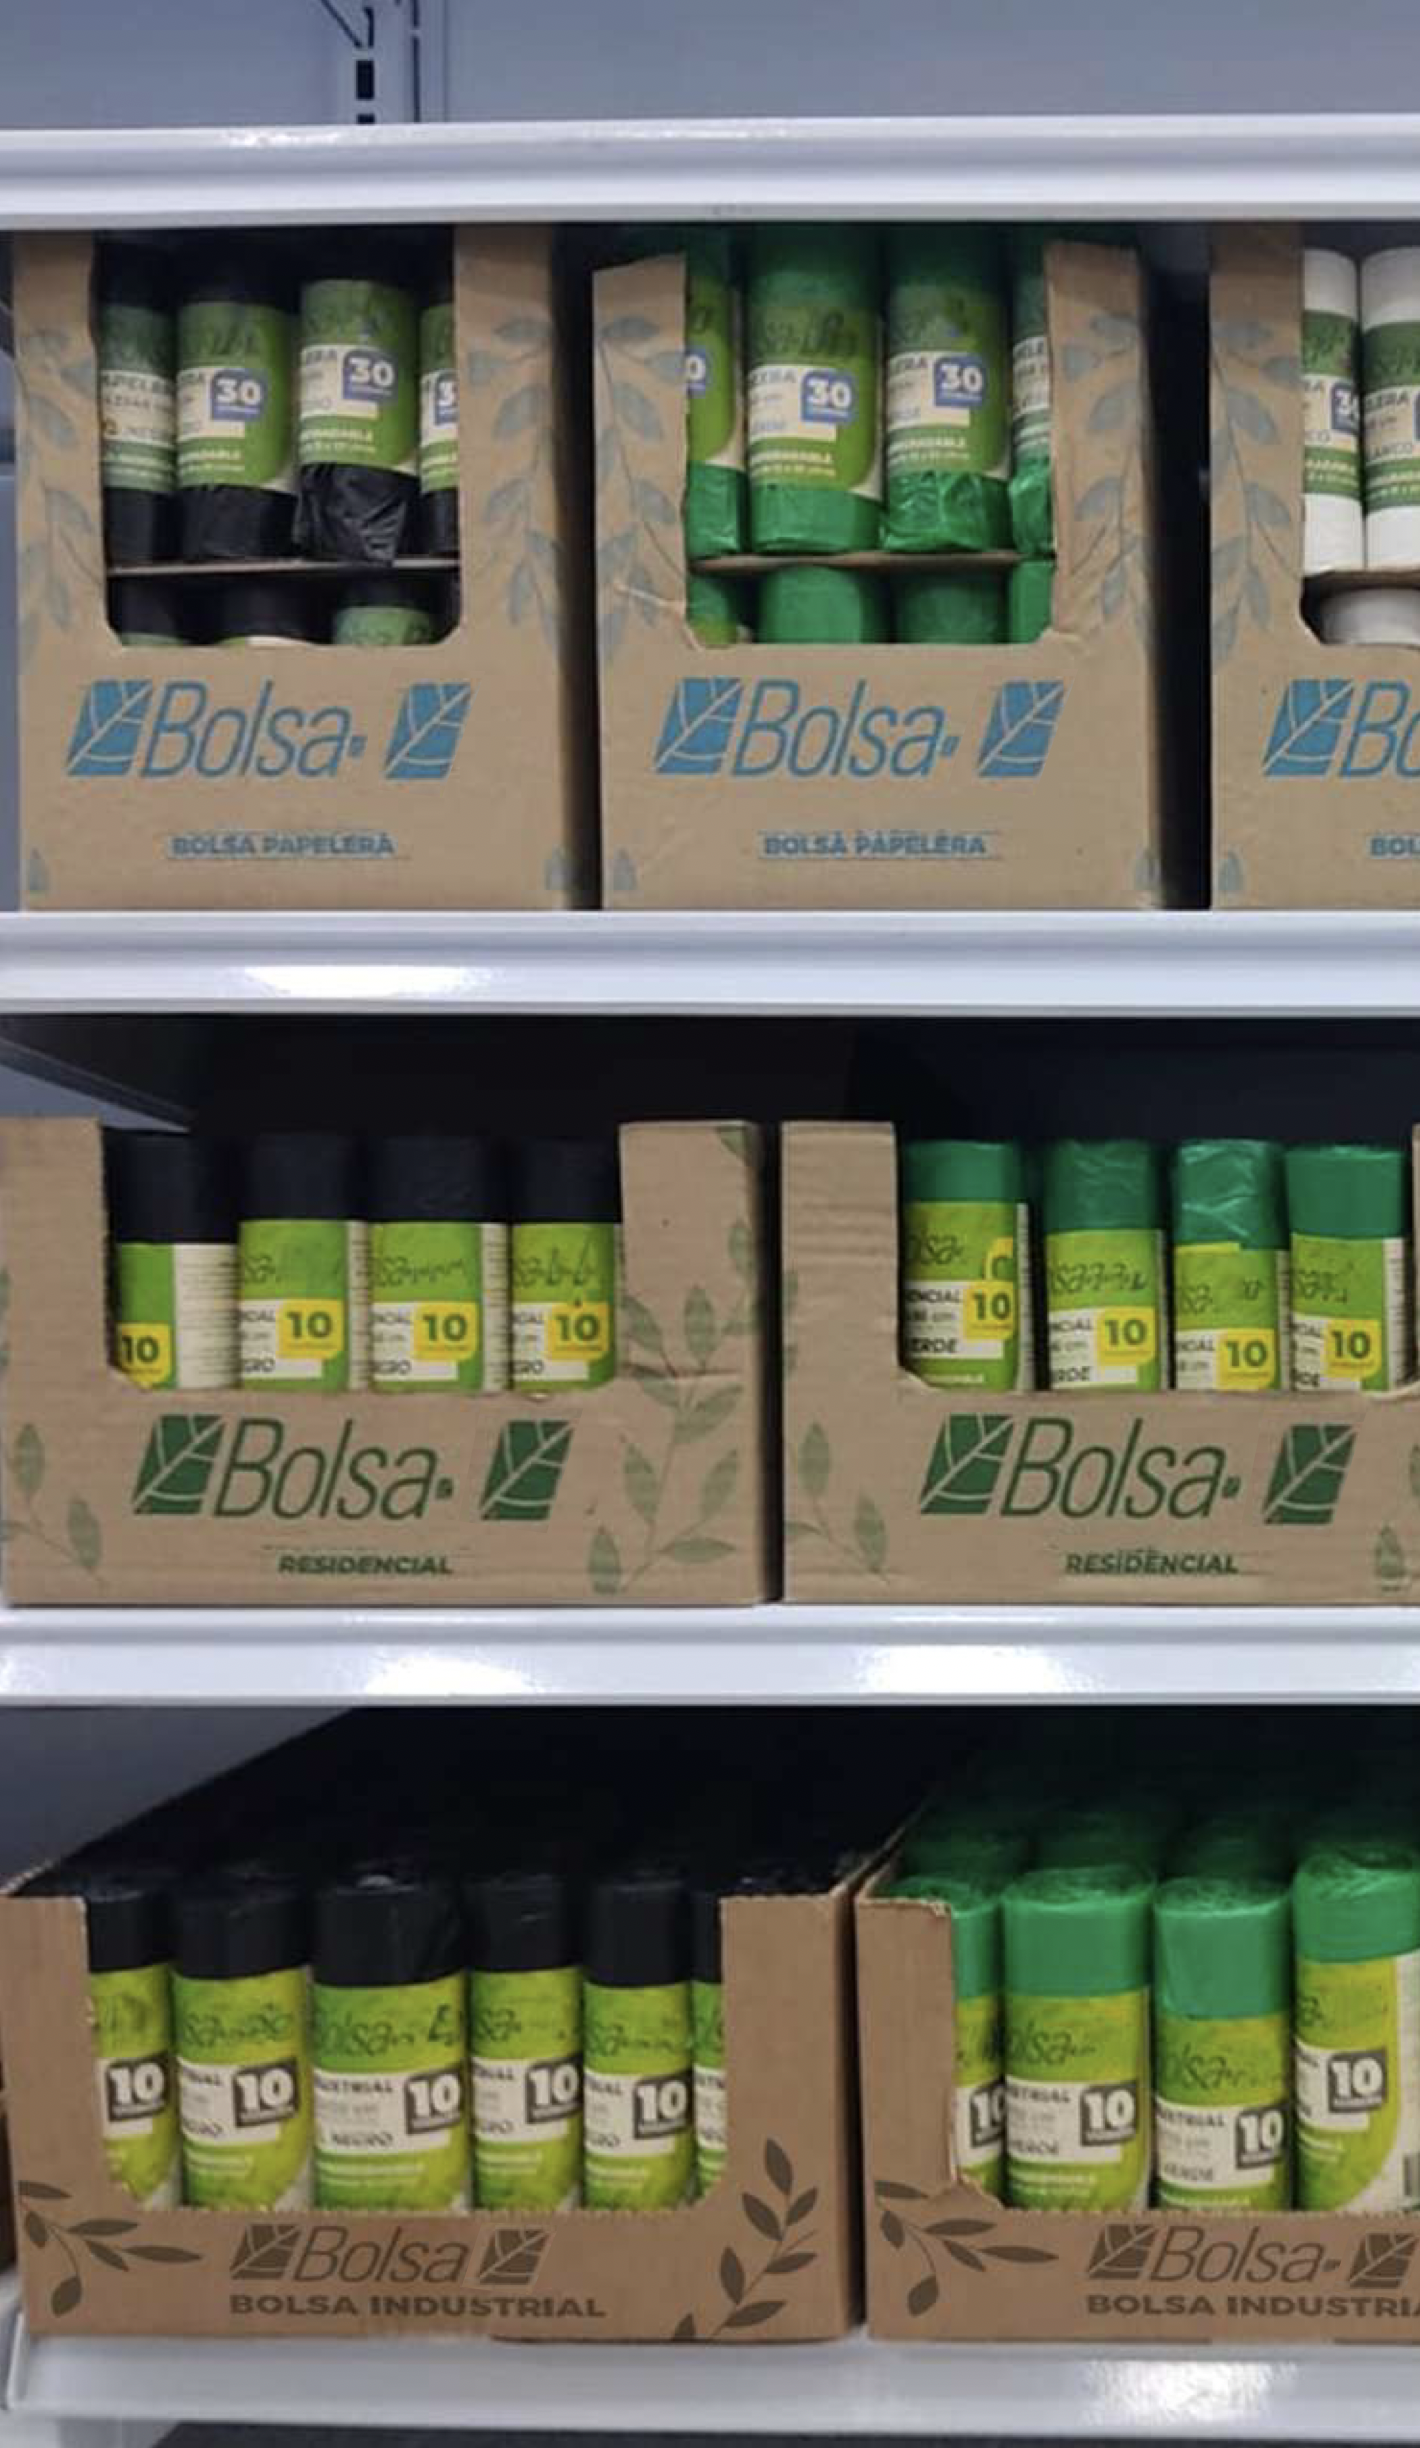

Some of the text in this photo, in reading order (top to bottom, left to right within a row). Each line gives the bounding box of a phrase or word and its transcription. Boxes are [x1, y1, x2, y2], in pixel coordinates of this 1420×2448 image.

[349, 357, 395, 389] 30
[940, 364, 984, 392] 30
[216, 378, 263, 408] 30
[806, 377, 853, 409] 30
[172, 835, 394, 856] BOLSA PAPELERA
[763, 836, 986, 856] BOLSA PAPELERA
[974, 1292, 1012, 1321] 10
[285, 1311, 332, 1339] 10
[423, 1314, 467, 1342] 10
[554, 1314, 599, 1342] 10
[1105, 1318, 1148, 1347] 10
[122, 1336, 159, 1365] 10
[1226, 1340, 1268, 1368] 10
[1331, 1330, 1371, 1360] 10
[279, 1555, 453, 1574] RESIDENCIAL
[1066, 1555, 1240, 1575] RESIDENCIAL
[109, 2061, 165, 2106] 10
[234, 2068, 294, 2112] 10
[528, 2064, 579, 2106] 10
[1331, 2055, 1383, 2099] 10
[408, 2074, 461, 2118] 10
[637, 2081, 688, 2121] 10
[1083, 2088, 1136, 2131] 10
[1238, 2109, 1284, 2153] 10
[293, 2225, 470, 2284] Bolsa
[229, 2295, 607, 2318] BOLSA INDUSTRIAL
[1087, 2295, 1215, 2316] BOLSA
